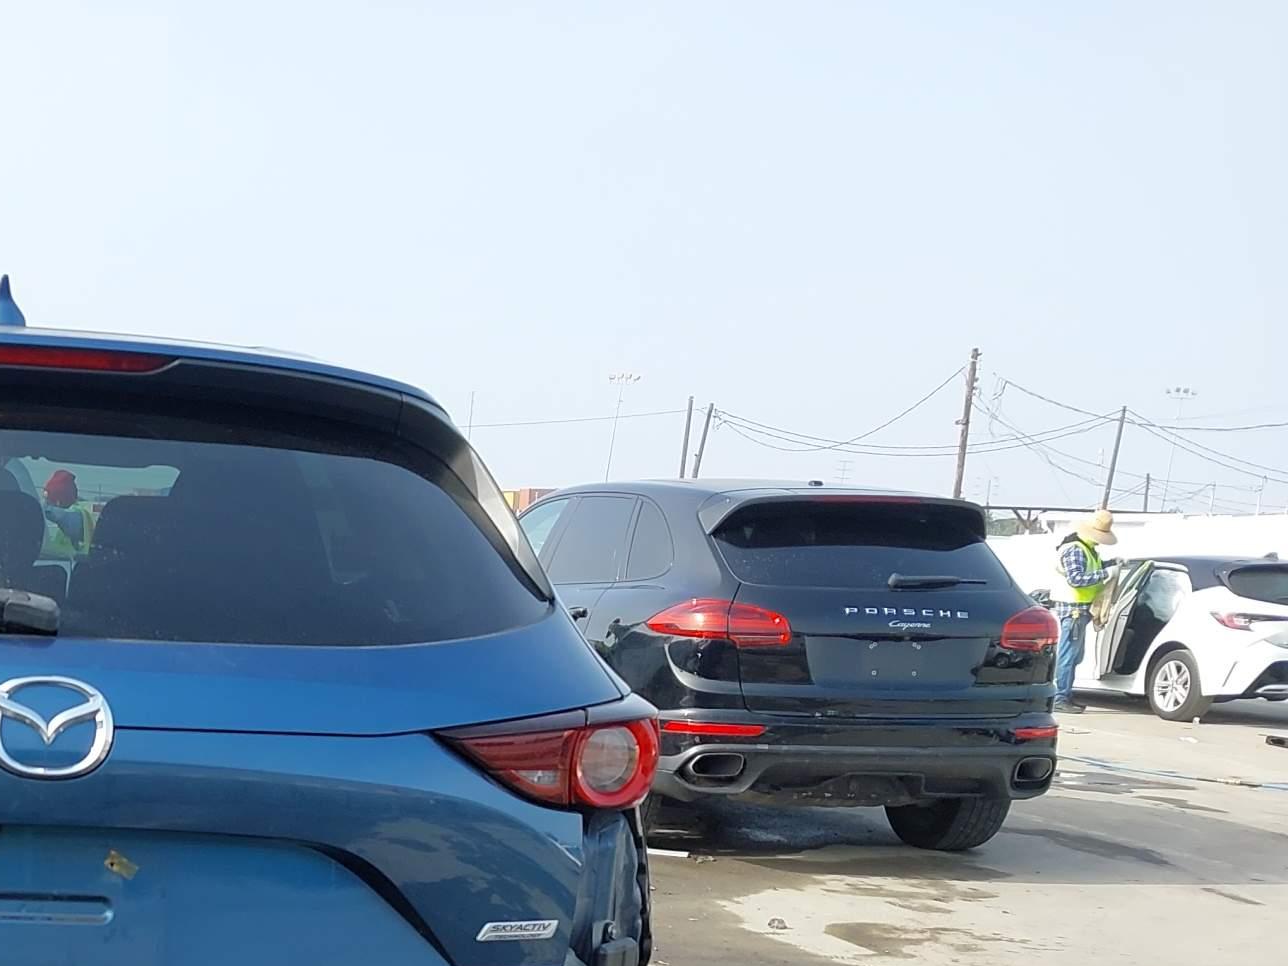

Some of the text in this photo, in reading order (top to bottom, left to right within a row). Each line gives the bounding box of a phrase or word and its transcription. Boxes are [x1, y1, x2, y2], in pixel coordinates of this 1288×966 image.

[844, 607, 969, 619] PORSCHE
[888, 620, 932, 631] Cayenne
[490, 922, 552, 932] SKYACTIV
